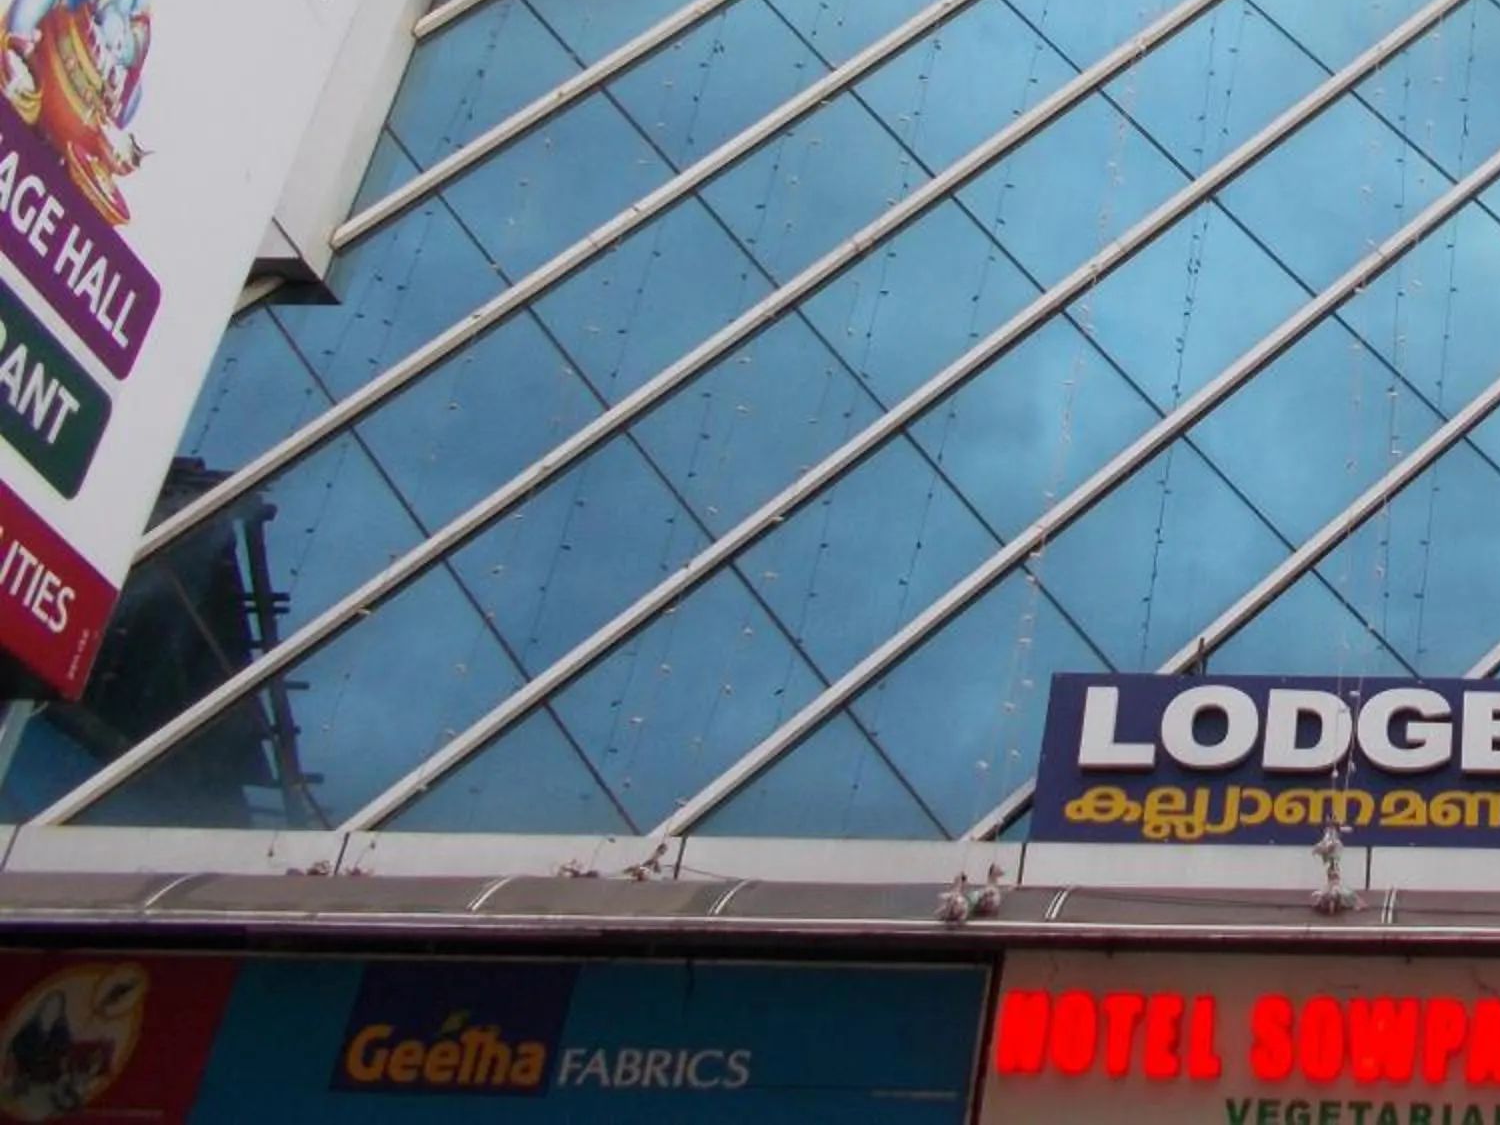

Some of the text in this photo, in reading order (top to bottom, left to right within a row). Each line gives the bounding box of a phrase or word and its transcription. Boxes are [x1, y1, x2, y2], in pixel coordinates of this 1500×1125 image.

[0, 132, 137, 349] AGE HALL
[0, 318, 80, 444] ANT
[0, 525, 76, 634] ITIES
[558, 1047, 752, 1089] FABRICS
[996, 990, 1222, 1078] HOTEL
